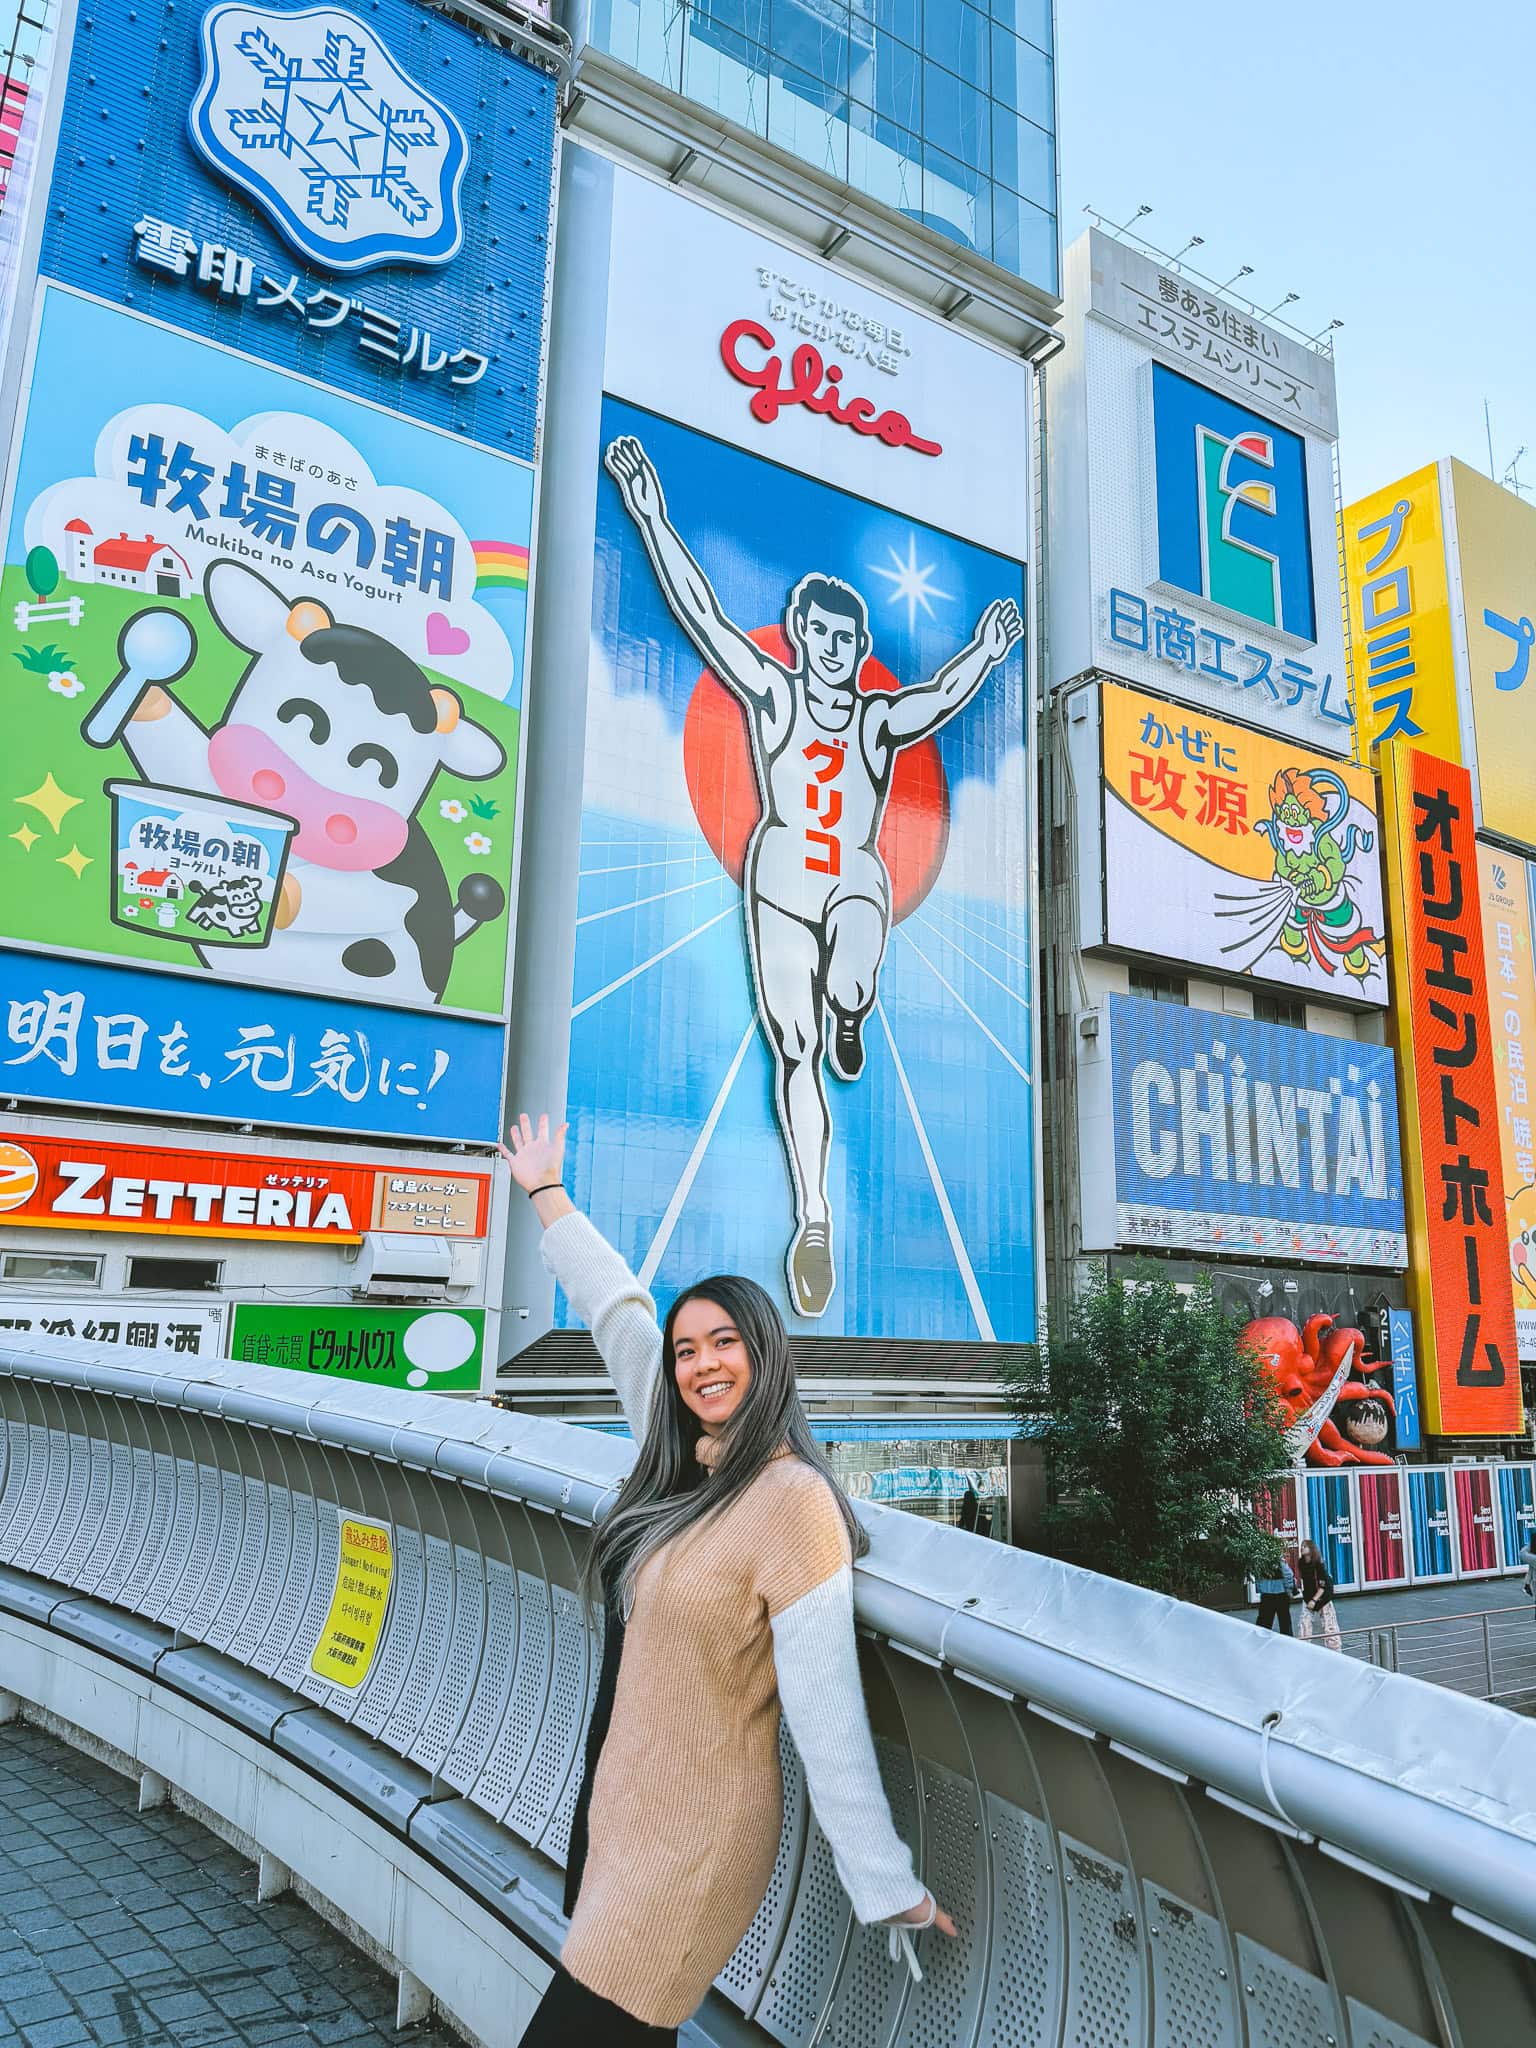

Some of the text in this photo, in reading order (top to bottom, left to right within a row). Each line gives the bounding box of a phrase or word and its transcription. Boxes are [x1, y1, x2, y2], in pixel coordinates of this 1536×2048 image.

[133, 213, 489, 385] 雪印メグミルク
[1158, 273, 1280, 360] 夢ある住まい
[720, 319, 943, 457] Glico
[1138, 302, 1302, 410] エステムシリーズ
[255, 444, 358, 491] まきばのあさ
[127, 432, 456, 602] 牧場の朝
[185, 523, 403, 604] Makiba no Asa Yogurt
[1110, 587, 1355, 726] 日商エステム
[1358, 499, 1425, 745] プロミス
[1139, 712, 1238, 772] かぜに
[802, 738, 848, 877] グリコ
[1128, 750, 1250, 836] 改源
[139, 822, 261, 870] 牧場の朝
[169, 857, 226, 877] ヨーグルト
[1413, 788, 1506, 1388] オリエントホーム
[265, 1173, 329, 1189] ゼッテリア
[388, 1201, 452, 1214] フェアトレード
[391, 1179, 469, 1196] 絶品バーガー
[415, 1215, 466, 1228] コーヒー
[308, 1328, 396, 1370] ピタットハウス
[1380, 1308, 1388, 1347] 2F
